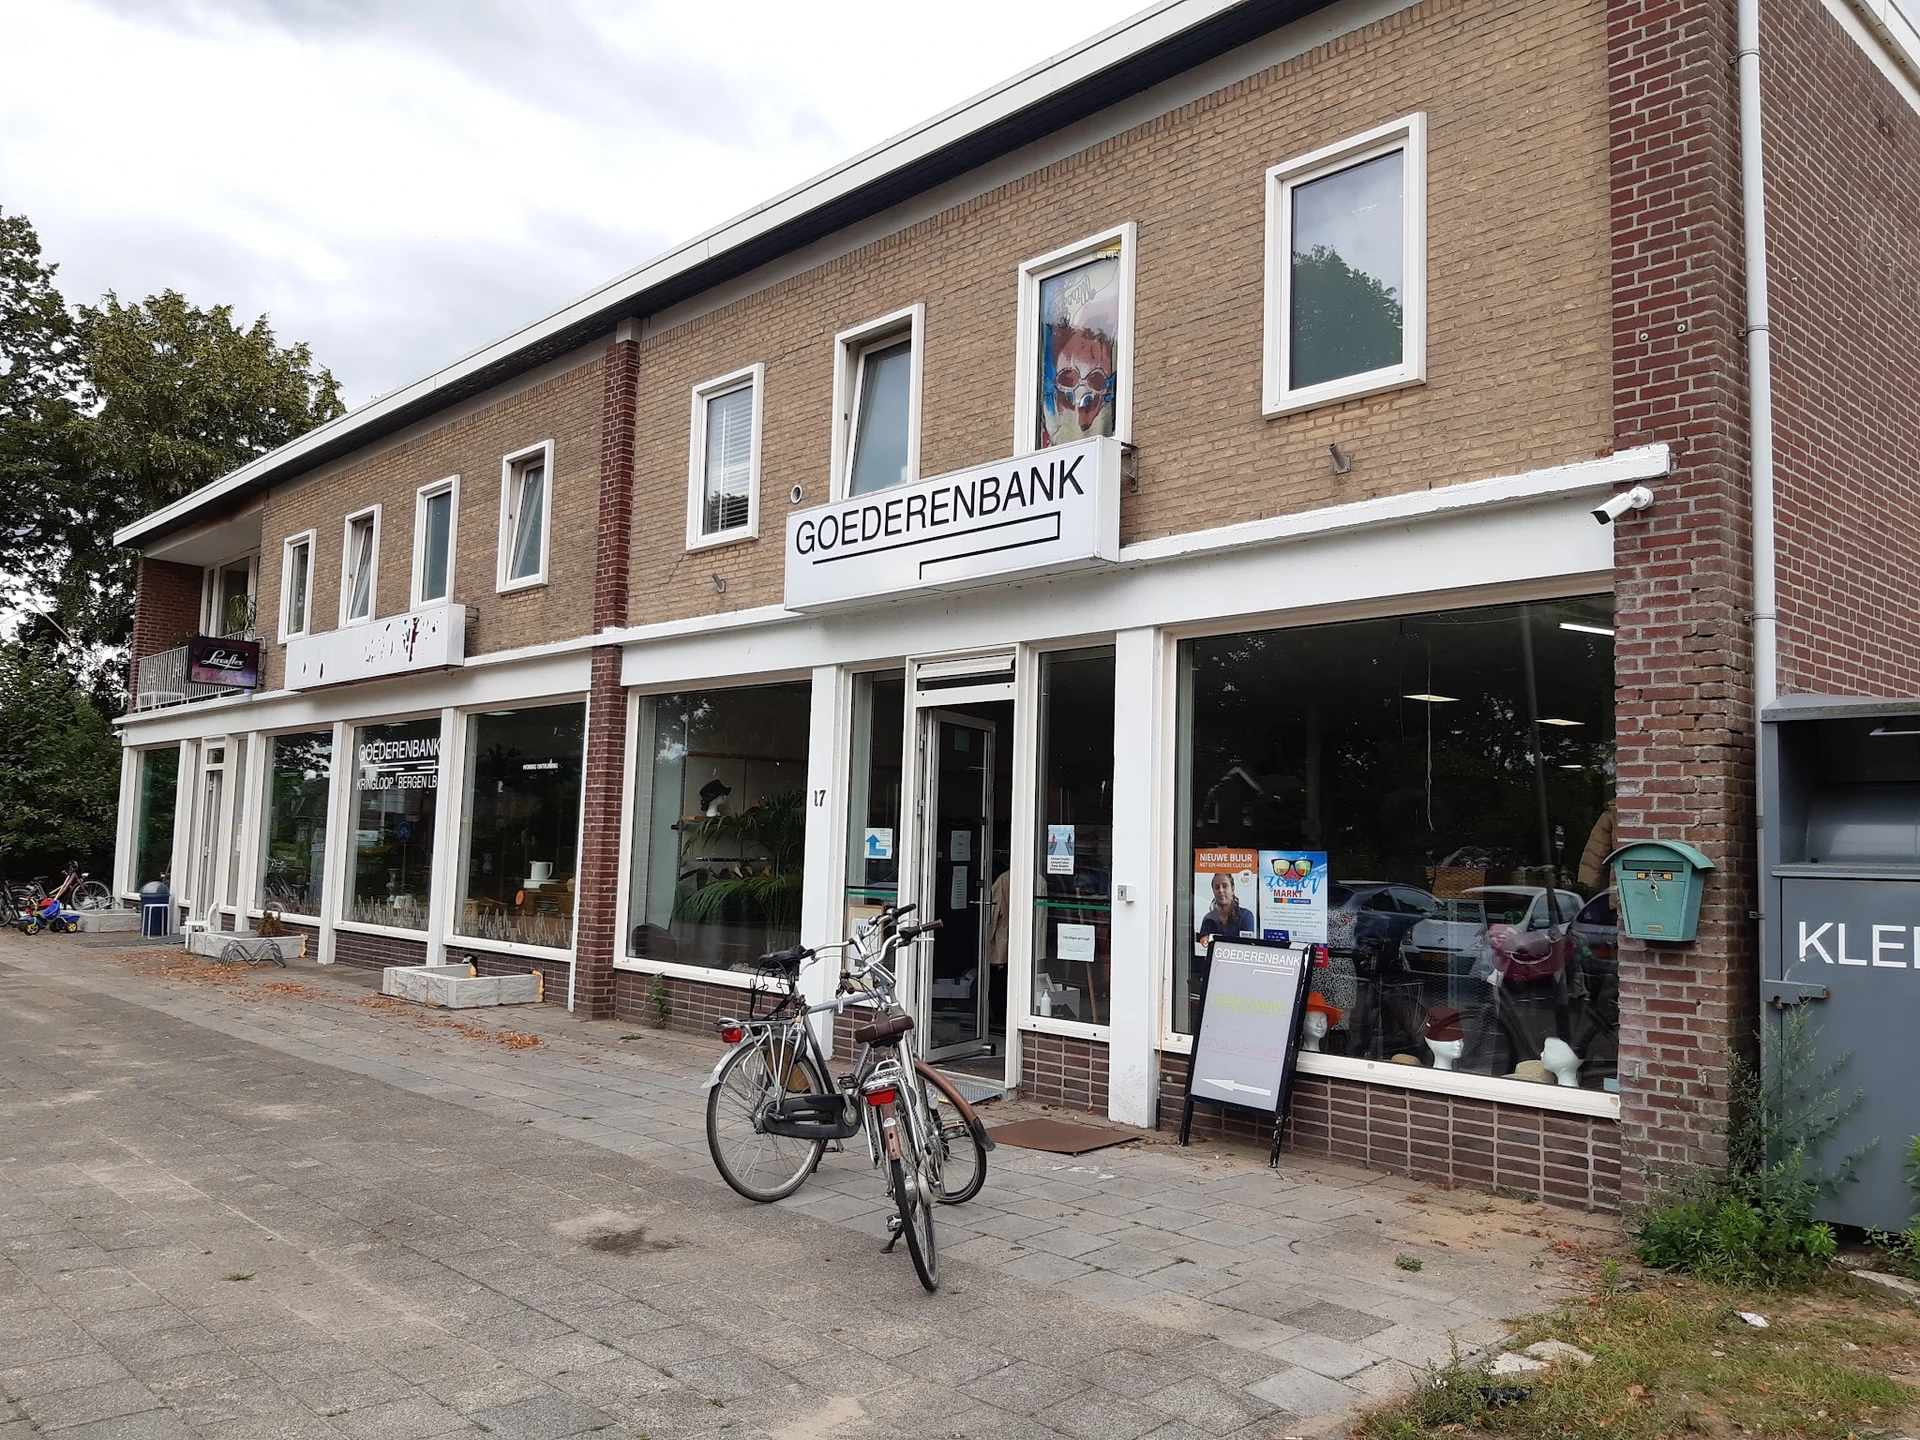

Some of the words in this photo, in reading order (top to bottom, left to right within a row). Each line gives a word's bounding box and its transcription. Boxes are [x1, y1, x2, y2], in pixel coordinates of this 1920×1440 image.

[796, 455, 1085, 555] GOEDERENBANK
[201, 649, 245, 669] Luxaflex
[359, 737, 441, 761] GOEDERENBANK
[356, 777, 393, 790] KRINGLOOP
[398, 775, 427, 789] BERGEN
[428, 775, 438, 788] LB
[814, 789, 826, 807] 17
[1199, 853, 1228, 862] NIEUWE
[1230, 854, 1253, 863] BUUR
[1273, 889, 1303, 898] MARKT
[1214, 947, 1301, 966] GOEDERENBANK
